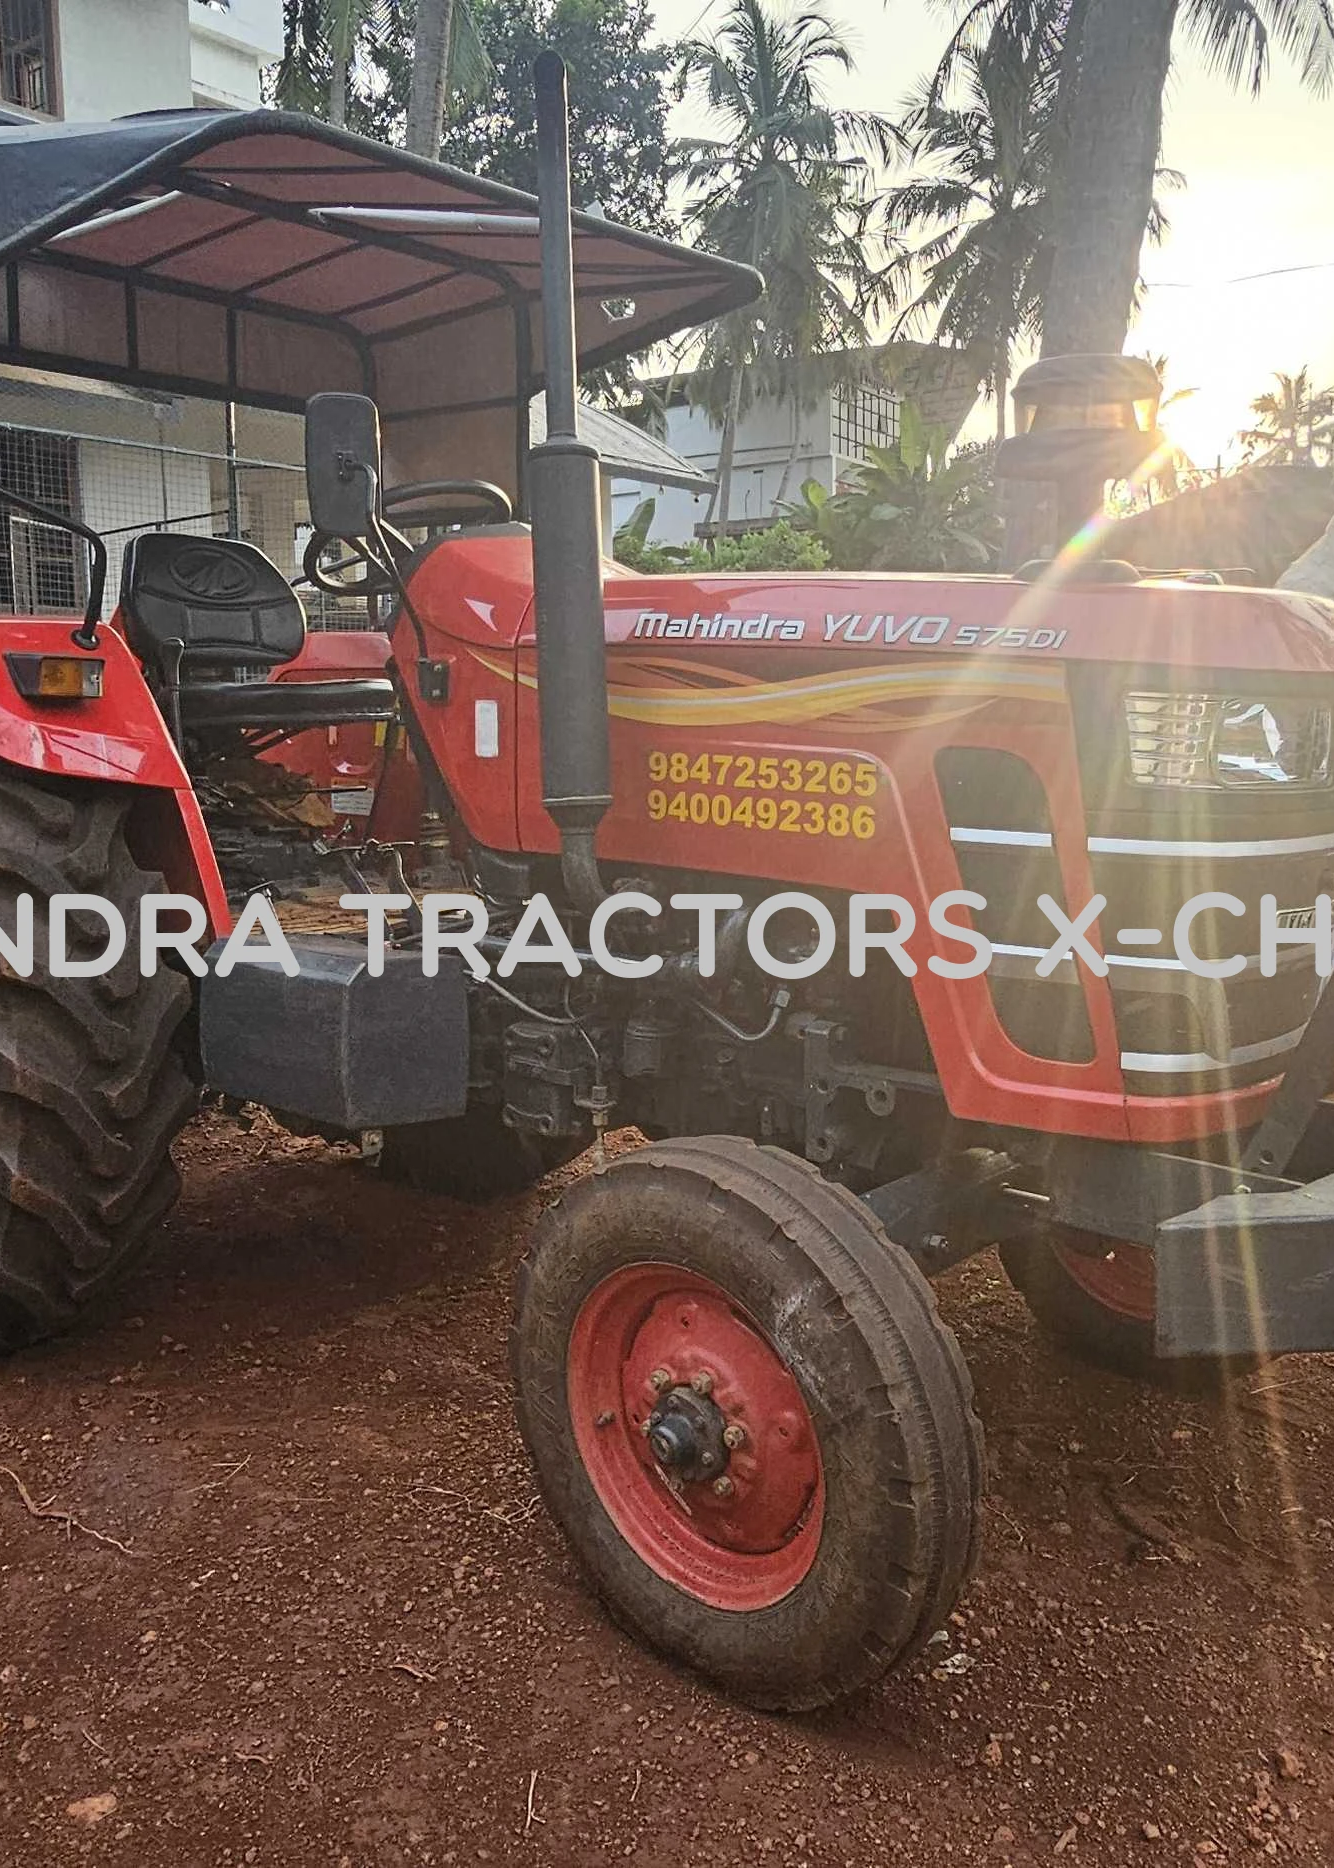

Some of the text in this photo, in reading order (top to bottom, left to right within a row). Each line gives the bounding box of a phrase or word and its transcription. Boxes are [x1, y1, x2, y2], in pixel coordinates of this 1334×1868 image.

[635, 612, 805, 641] Mahindra
[822, 614, 952, 645] YUVO
[648, 751, 878, 797] 9847253265
[648, 790, 876, 839] 9400492386
